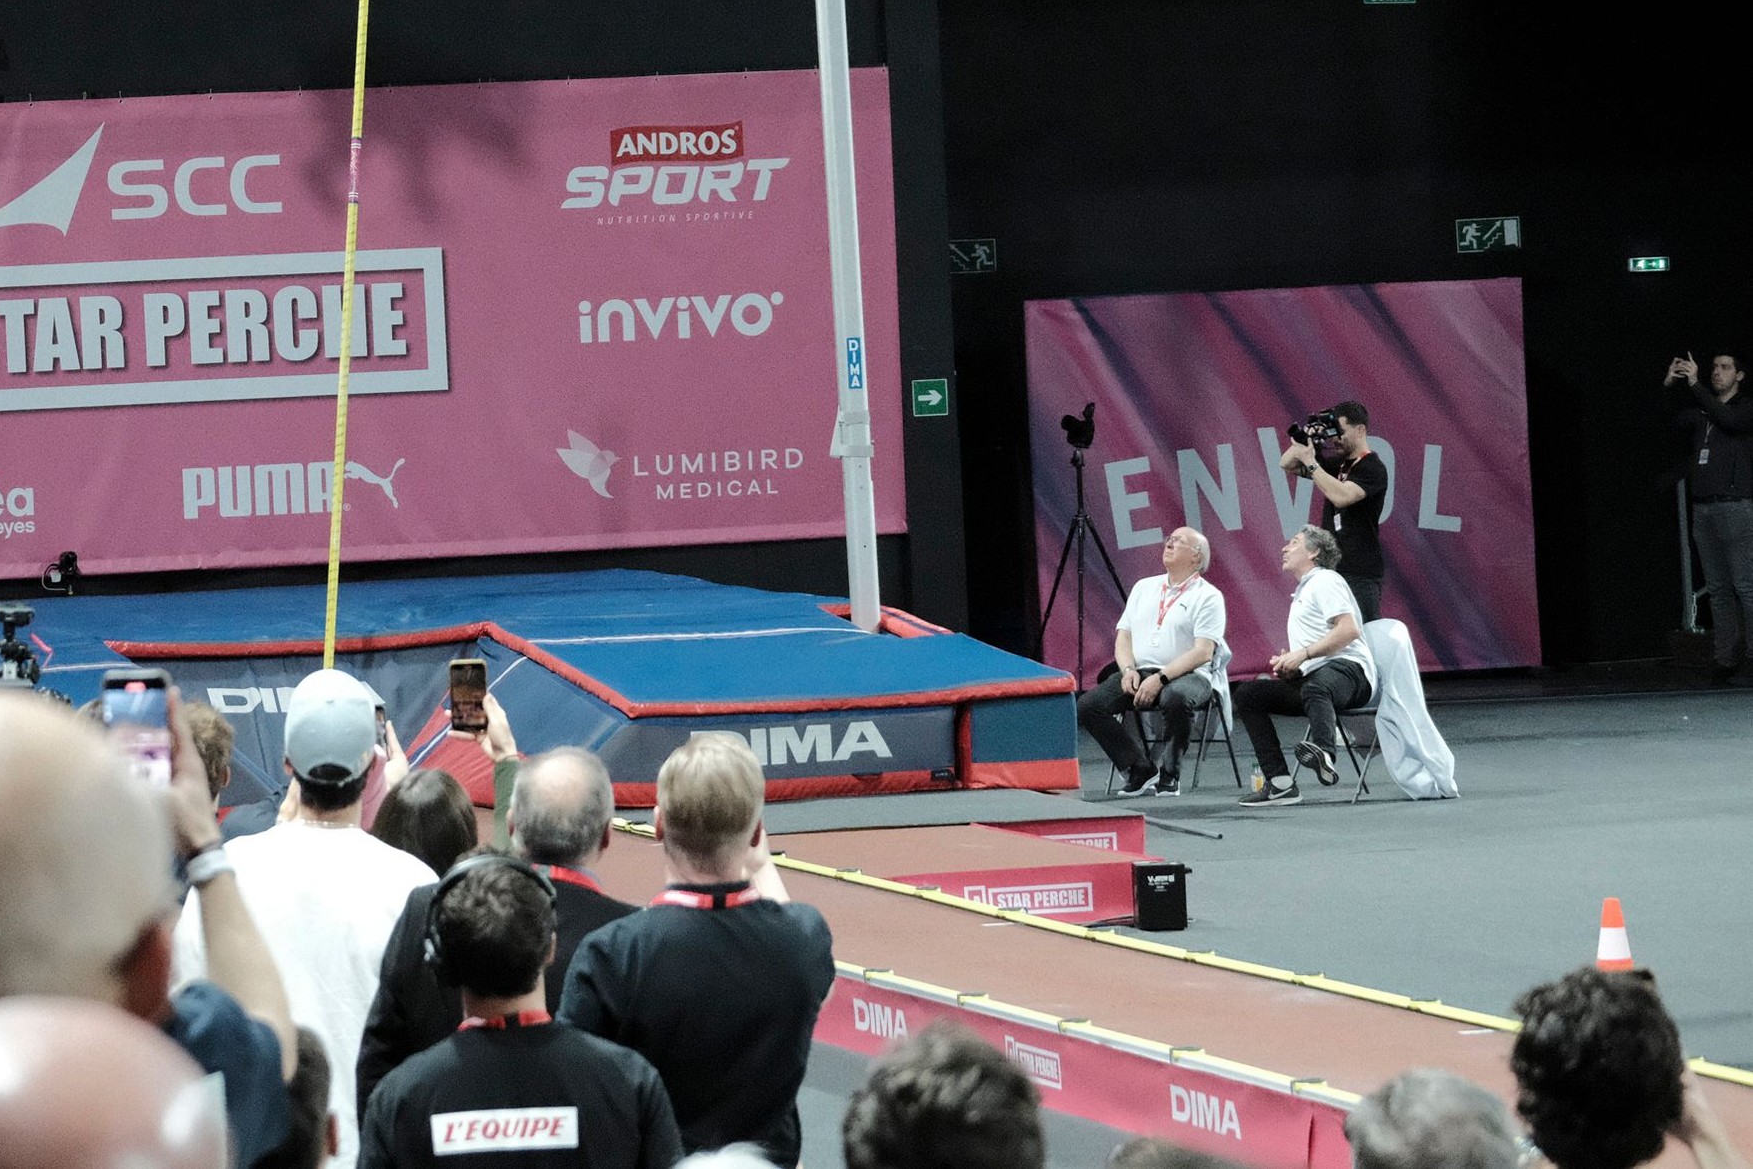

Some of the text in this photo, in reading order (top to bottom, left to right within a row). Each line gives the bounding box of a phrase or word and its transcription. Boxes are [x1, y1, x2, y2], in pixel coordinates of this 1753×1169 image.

[616, 129, 737, 158] ANDROS
[107, 154, 283, 220] SCC
[560, 157, 790, 209] SPORT
[596, 210, 754, 225] NUTRITION SPORTIVE
[144, 282, 407, 368] PERCHE
[848, 339, 861, 388] DIMA
[633, 448, 804, 477] LUMIBIRD
[182, 461, 338, 519] PUMA
[657, 478, 778, 500] MEDICAL
[996, 892, 1031, 909] STAR
[1034, 889, 1086, 907] PERCHE
[853, 998, 909, 1040] DIMA
[443, 1115, 568, 1143] L'EQUIPE
[1169, 1083, 1242, 1140] DIMA
